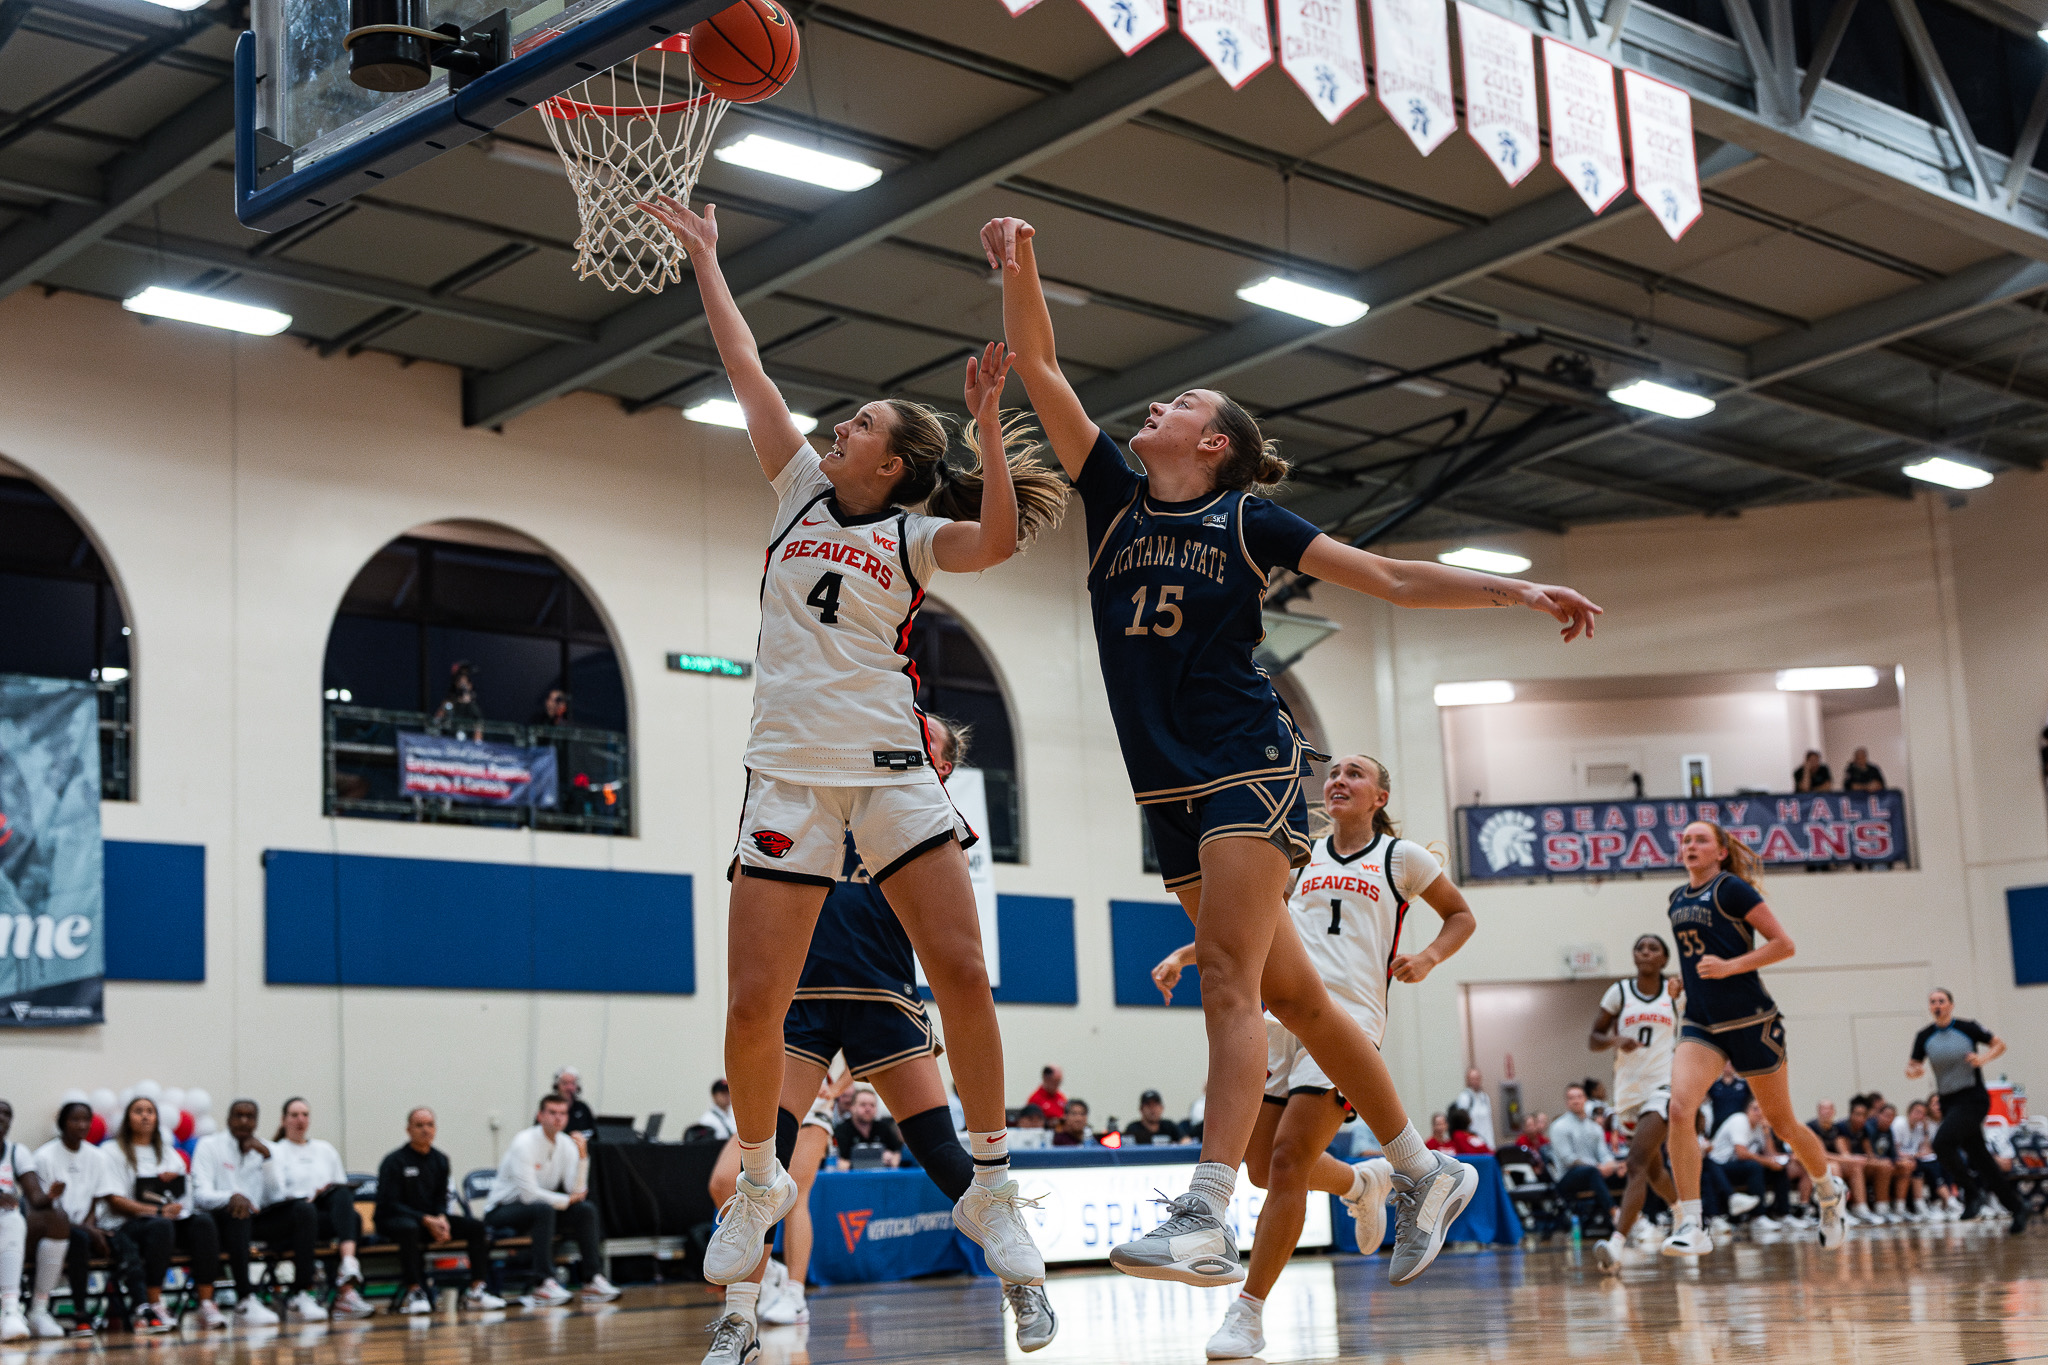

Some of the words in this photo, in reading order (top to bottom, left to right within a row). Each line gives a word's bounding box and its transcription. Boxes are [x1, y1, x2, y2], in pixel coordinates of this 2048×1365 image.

[1482, 65, 1523, 98] 2019
[1213, 514, 1227, 523] SKY
[873, 531, 897, 552] WCC
[781, 540, 893, 590] BEAVERS
[1181, 539, 1227, 585] STATE
[806, 571, 843, 624] 4
[1125, 585, 1184, 637] 15
[1542, 801, 1749, 832] SEABURY
[1776, 796, 1891, 824] HALL
[1543, 820, 1893, 871] SPATANS
[1361, 862, 1381, 874] WCC
[1301, 875, 1380, 902] BEAVERS
[1327, 898, 1342, 935] 1
[1677, 929, 1705, 958] 33
[1639, 1026, 1653, 1048] 0
[1082, 1195, 1261, 1247] SPARNS
